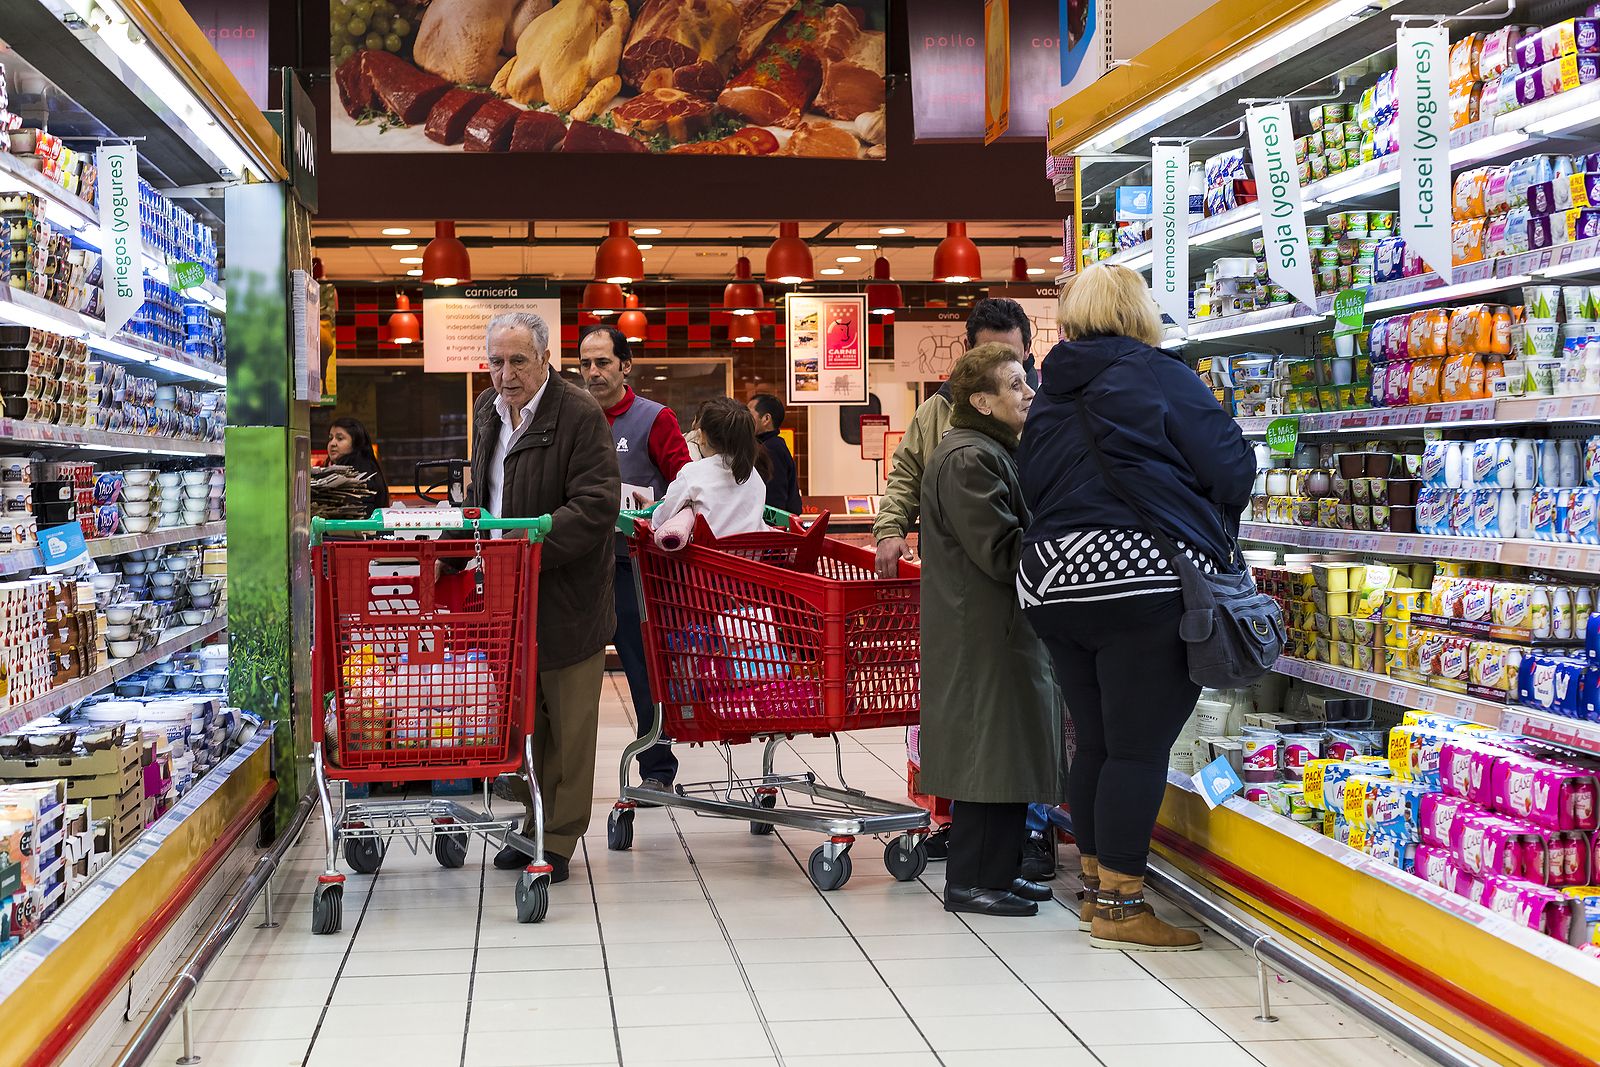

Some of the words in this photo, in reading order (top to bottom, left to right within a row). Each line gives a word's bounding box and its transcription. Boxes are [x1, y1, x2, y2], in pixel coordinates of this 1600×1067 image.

[924, 33, 976, 49] pollo
[1412, 41, 1438, 150] (yogures)
[1258, 116, 1294, 218] (yogures)
[108, 154, 129, 233] (yogures)
[1413, 157, 1434, 228] l-casei
[1162, 156, 1178, 293] cremosos/bicomp.
[1274, 224, 1299, 268] soja
[113, 237, 133, 298] griegos
[178, 270, 190, 280] EL
[465, 287, 518, 297] carnicería
[1336, 300, 1345, 310] EL
[1345, 294, 1362, 307] MÁS
[938, 312, 960, 320] ovino
[1337, 305, 1363, 319] BARATO
[1268, 428, 1275, 437] EL
[1277, 423, 1295, 436] MÁS
[1269, 433, 1296, 445] BARATO
[1477, 456, 1493, 470] Actimel
[1466, 598, 1485, 615] Actimel
[1505, 602, 1525, 620] Actimel
[1444, 655, 1462, 671] Actimel
[1482, 661, 1500, 679] Actimel
[1390, 737, 1408, 748] PACK
[1390, 747, 1408, 760] AHORRO
[1306, 771, 1322, 781] PACK
[1346, 787, 1364, 800] PACK
[1376, 798, 1400, 815] Actimel
[1350, 832, 1364, 844] PACK
